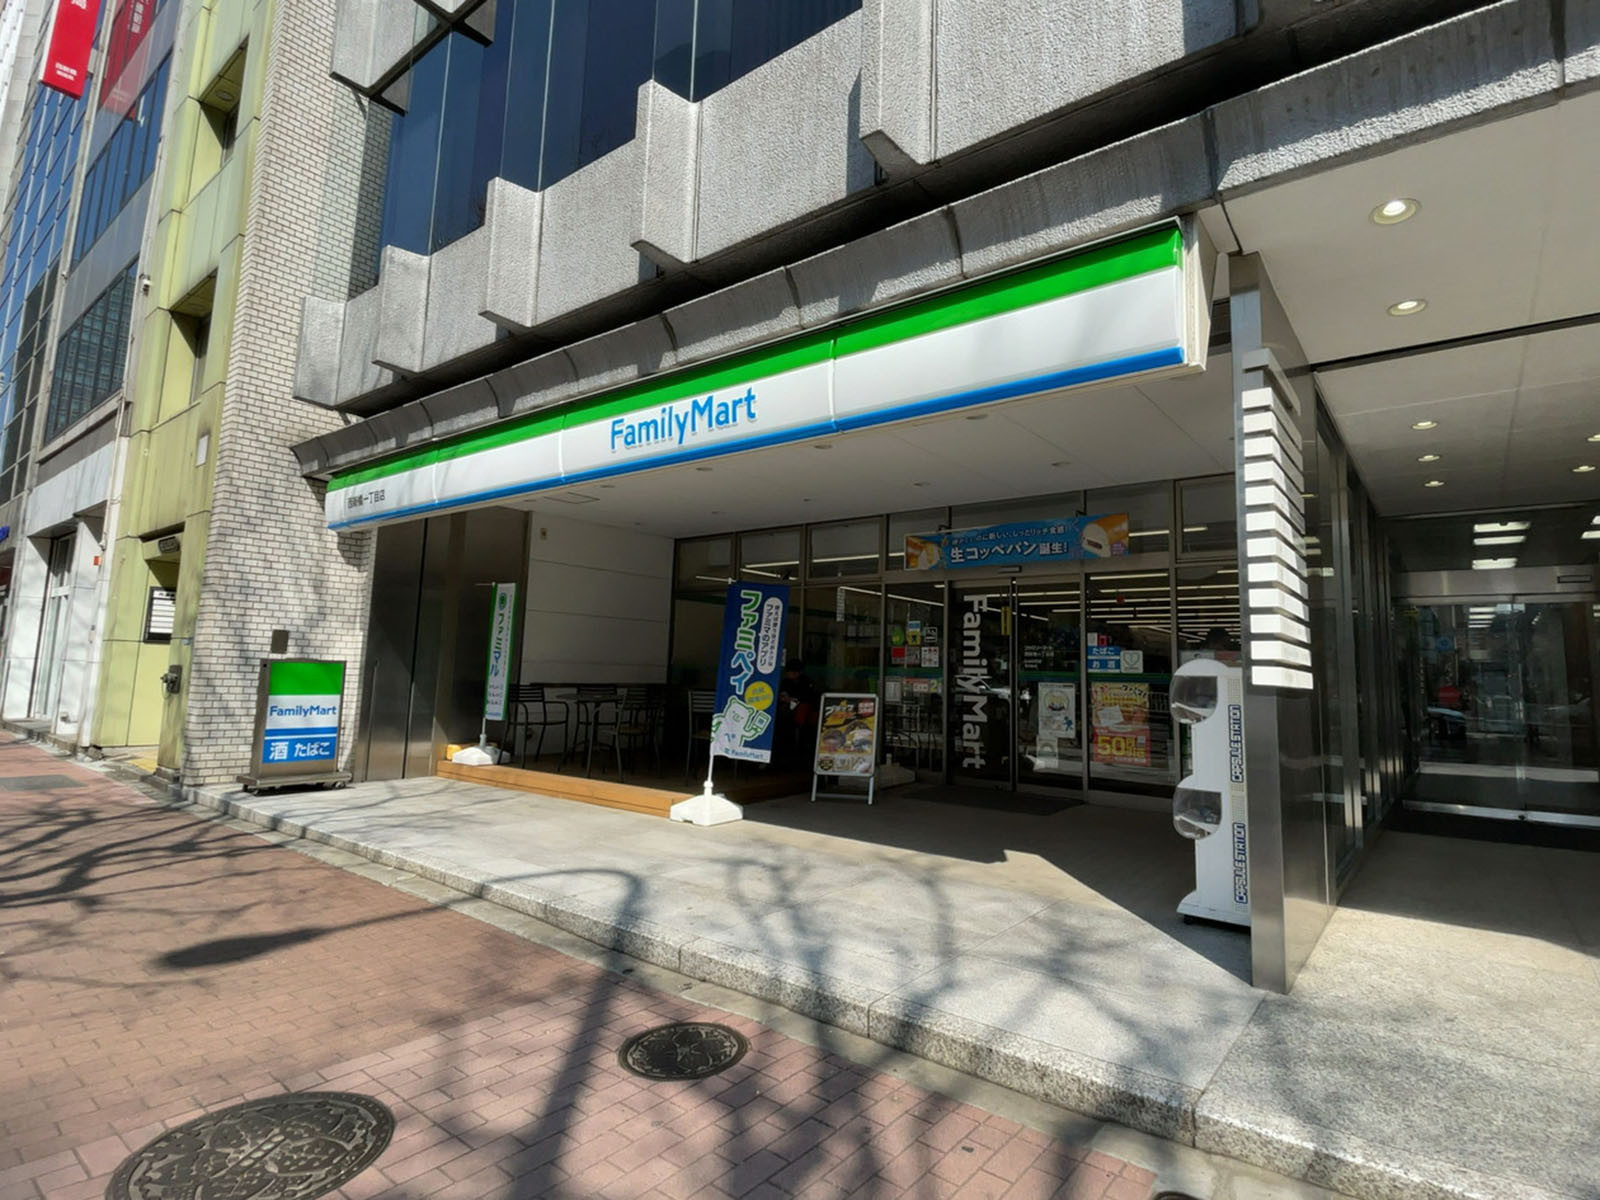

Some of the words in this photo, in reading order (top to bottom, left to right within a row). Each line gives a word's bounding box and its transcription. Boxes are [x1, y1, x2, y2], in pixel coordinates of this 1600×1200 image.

[610, 387, 756, 450] FamilyMart
[950, 541, 1069, 564] 生コッペパン誕生!
[730, 589, 762, 695] ファミペイ
[962, 594, 988, 769] FamilyMart
[269, 705, 337, 717] FamilyMart
[269, 741, 289, 761] 酒
[294, 742, 331, 758] たばこ
